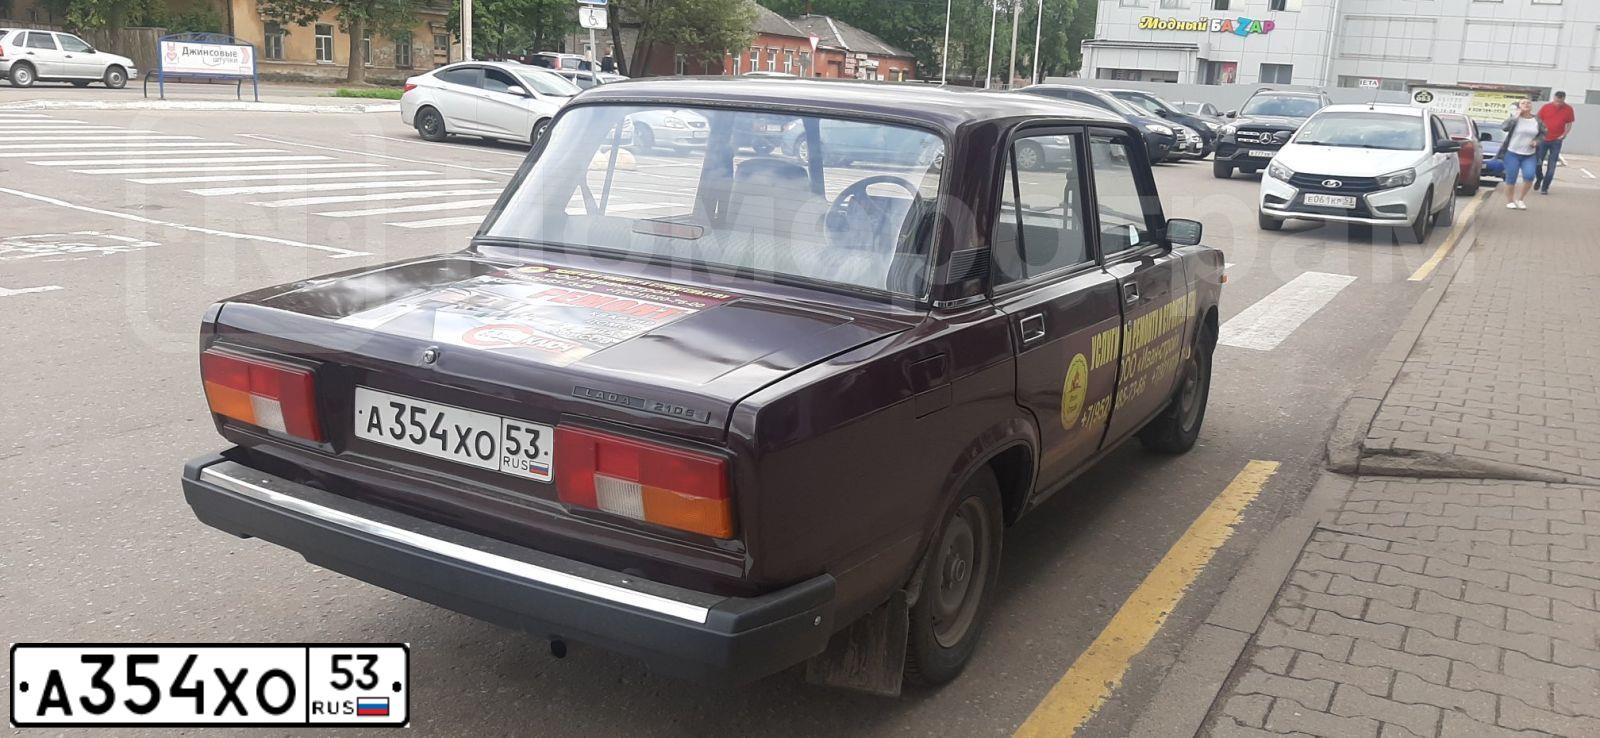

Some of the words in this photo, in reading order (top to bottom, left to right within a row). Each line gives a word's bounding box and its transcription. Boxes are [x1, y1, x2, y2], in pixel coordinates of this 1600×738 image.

[1138, 16, 1208, 32] Модный
[181, 46, 238, 58] Джинсовые
[212, 57, 238, 65] штучки
[524, 288, 685, 321] РЕМОНТ
[584, 388, 631, 406] LADA
[367, 401, 496, 460] А354ХО
[505, 424, 541, 459] 53
[503, 456, 528, 471] RUS
